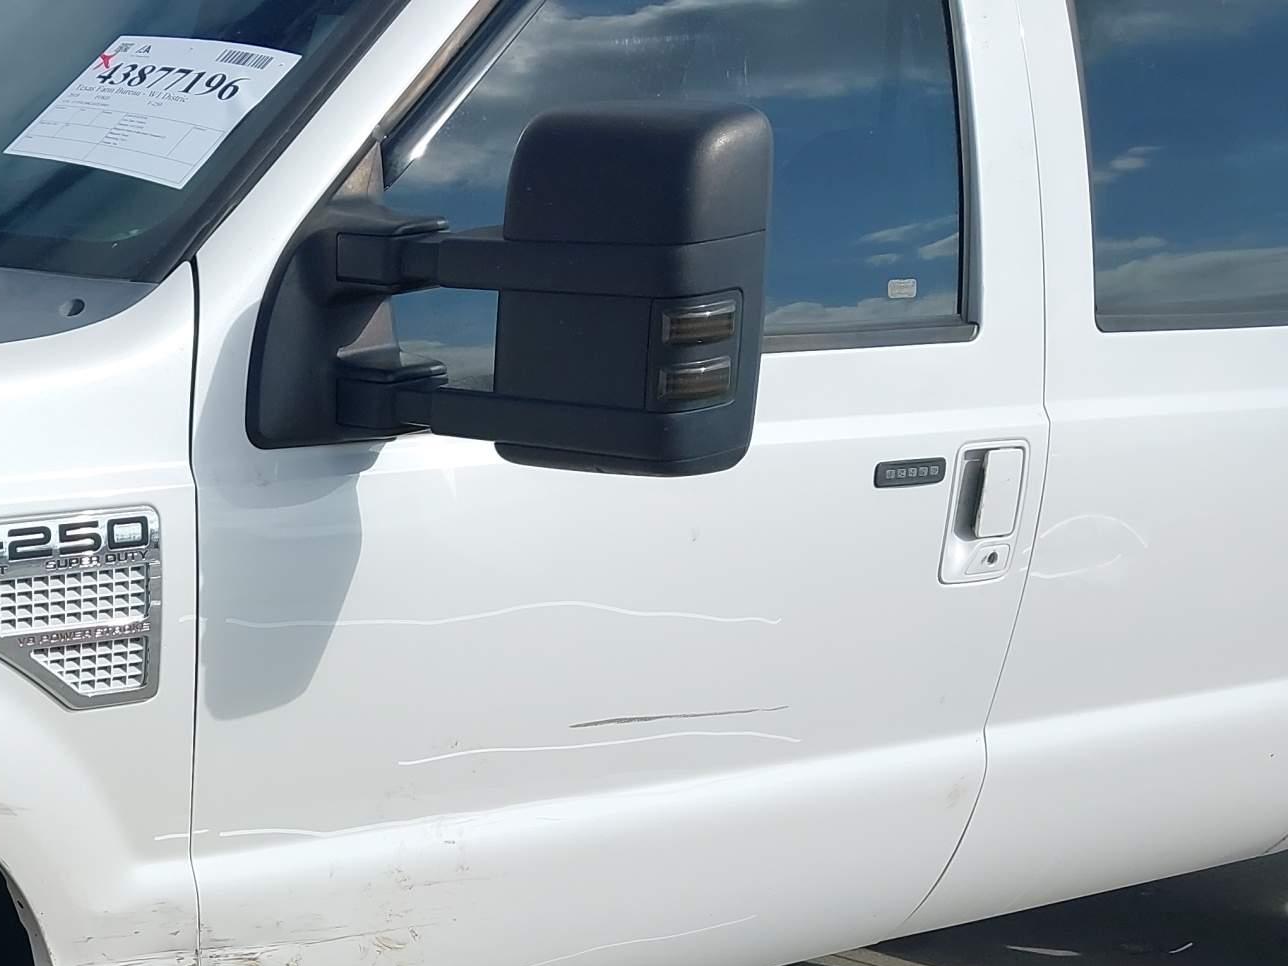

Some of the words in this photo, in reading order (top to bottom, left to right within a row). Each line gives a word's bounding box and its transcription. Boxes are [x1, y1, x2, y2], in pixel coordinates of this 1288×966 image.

[76, 84, 96, 92] Texas
[115, 87, 142, 96] Bureau
[96, 62, 250, 102] 43877196
[45, 555, 101, 571] SUPER
[105, 550, 149, 564] DUTY
[17, 636, 36, 647] V8
[39, 630, 92, 645] POWER
